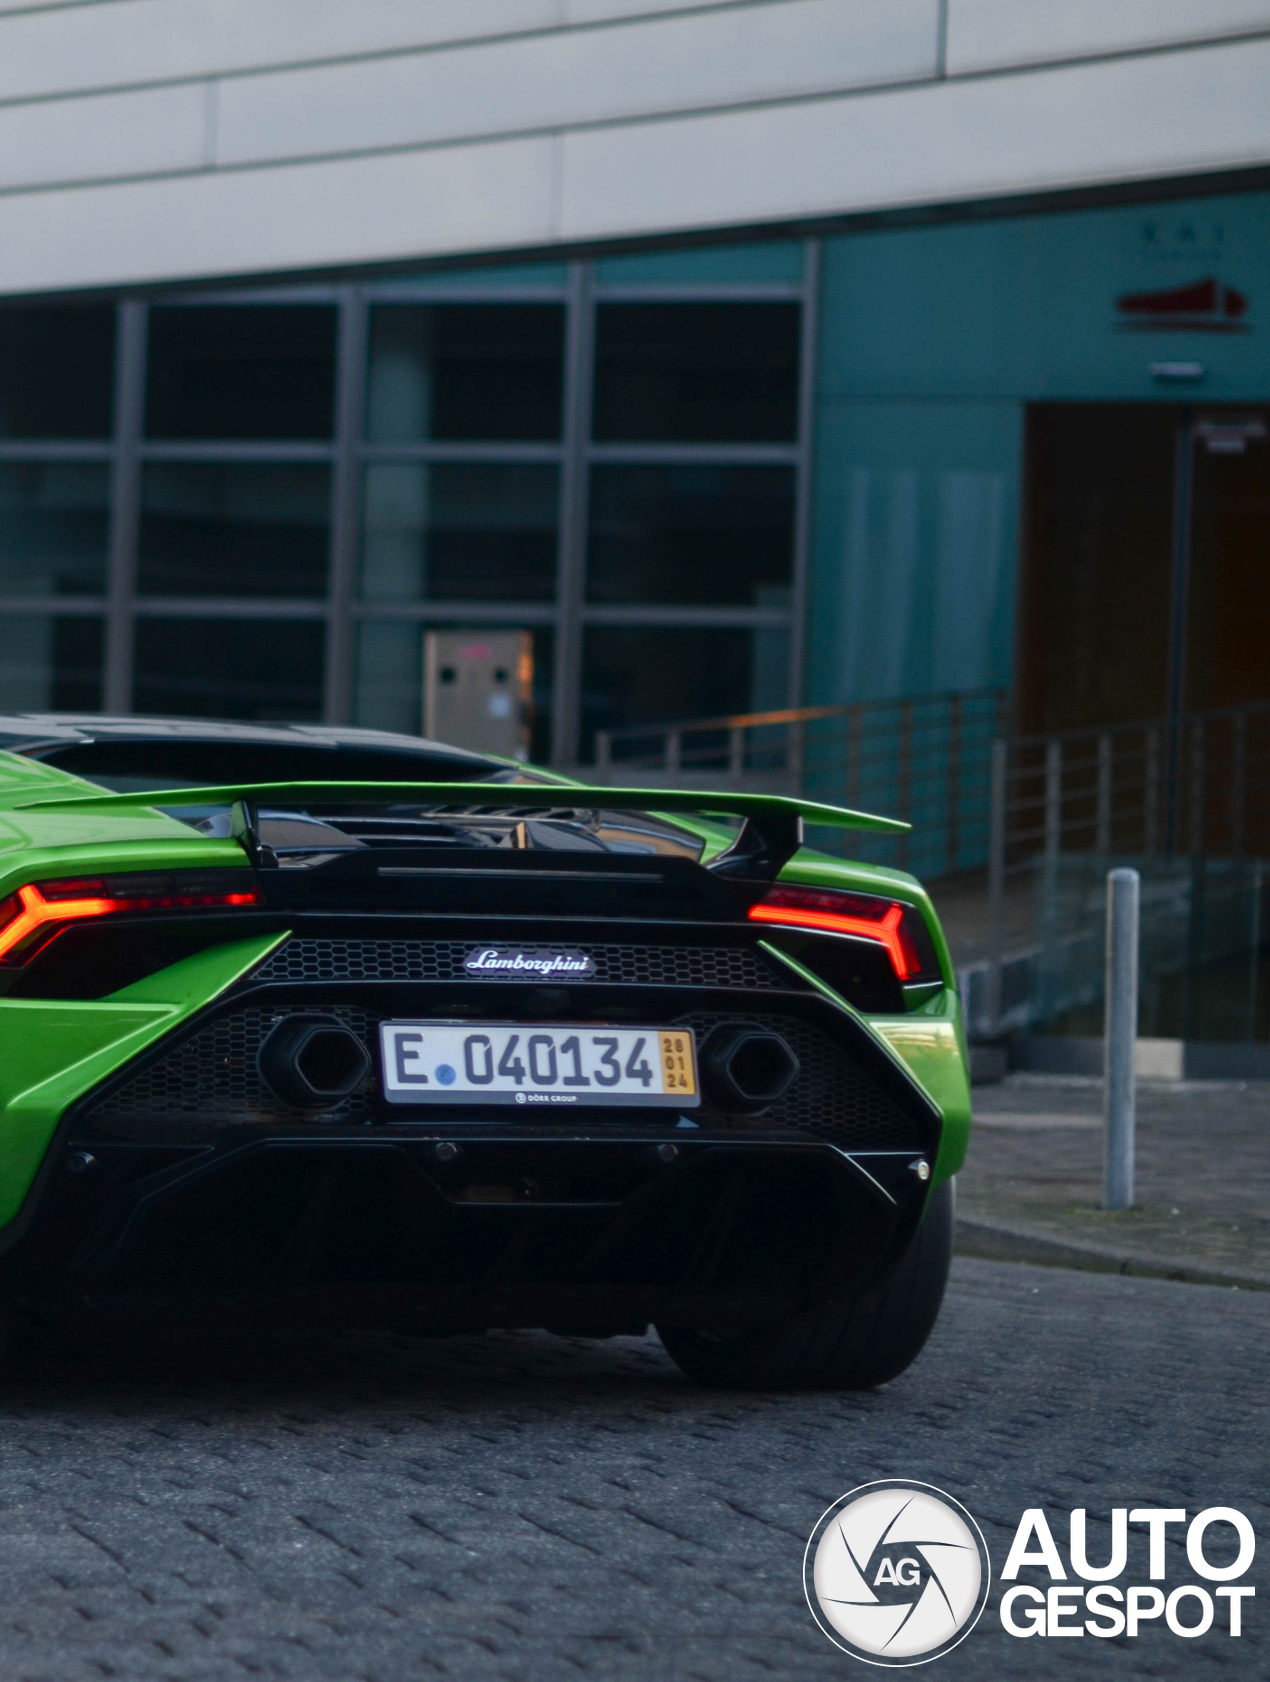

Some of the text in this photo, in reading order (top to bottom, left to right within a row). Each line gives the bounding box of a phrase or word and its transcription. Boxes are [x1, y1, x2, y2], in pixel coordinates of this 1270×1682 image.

[466, 949, 589, 975] Lamborghini
[393, 1032, 653, 1088] E 040134
[665, 1056, 685, 1070] 01
[667, 1073, 688, 1088] 24
